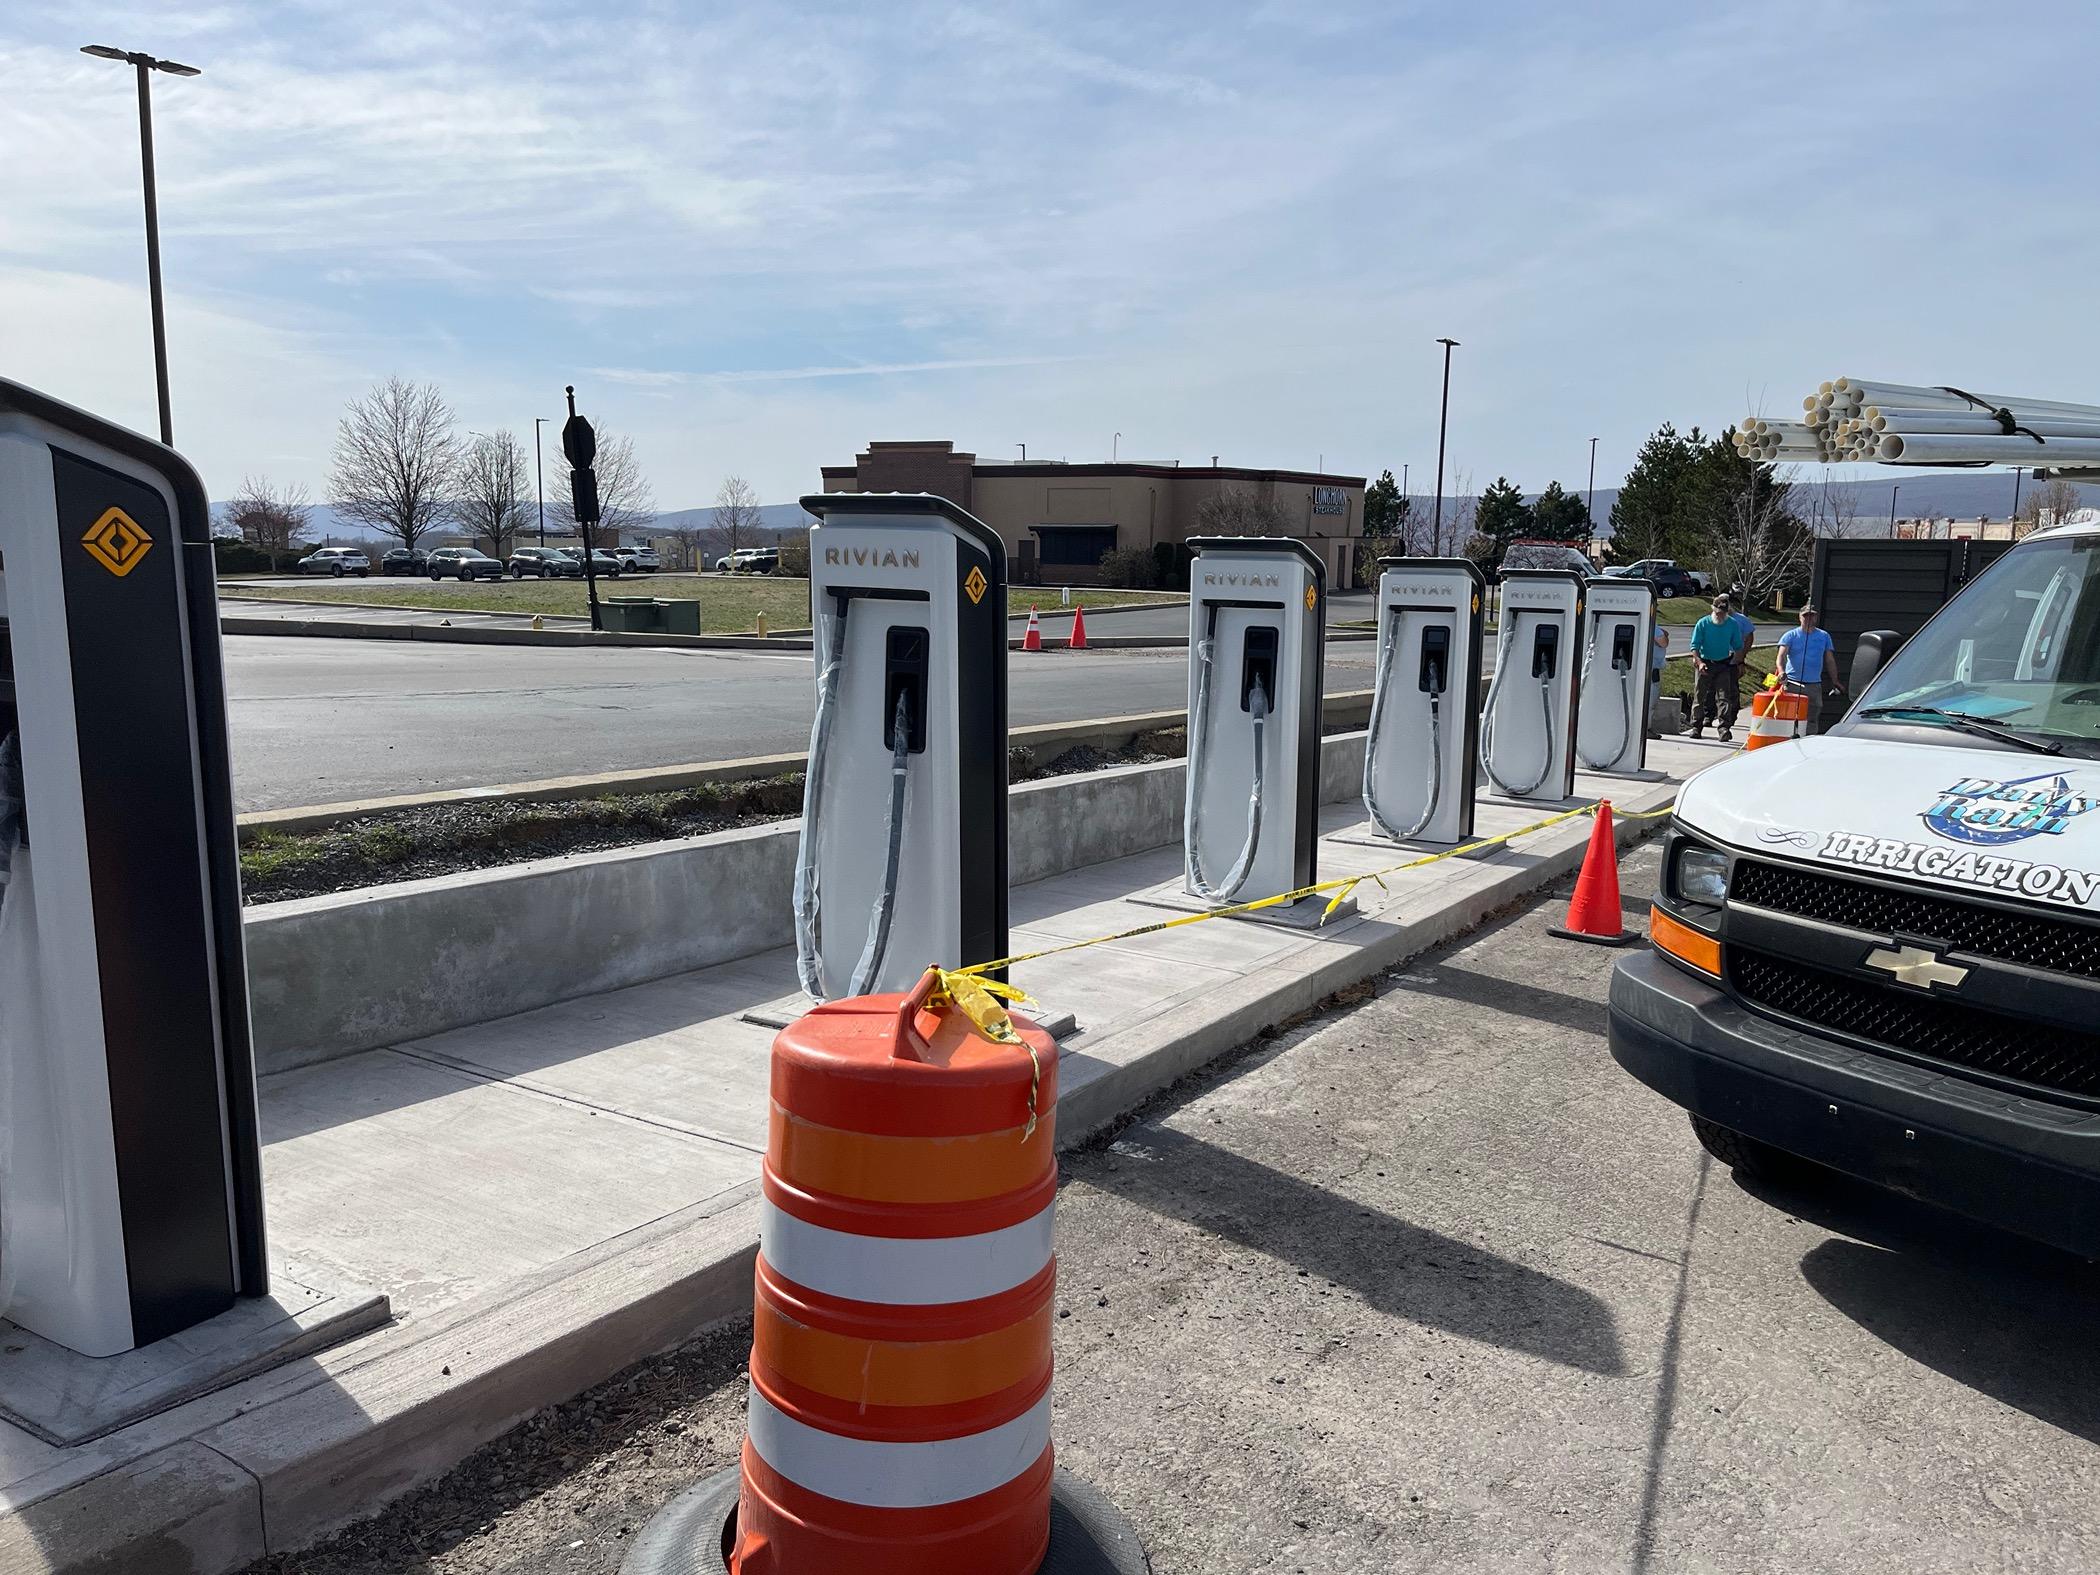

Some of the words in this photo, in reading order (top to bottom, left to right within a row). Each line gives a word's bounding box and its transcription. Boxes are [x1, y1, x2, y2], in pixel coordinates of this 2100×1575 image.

[825, 547, 920, 569] RIVIAN
[1204, 571, 1280, 587] RIVIAN
[1391, 583, 1453, 596] RIVIAN
[1938, 777, 2100, 817] Daily
[1916, 796, 2071, 835] Rain
[1818, 831, 2100, 905] IRRIGATION
